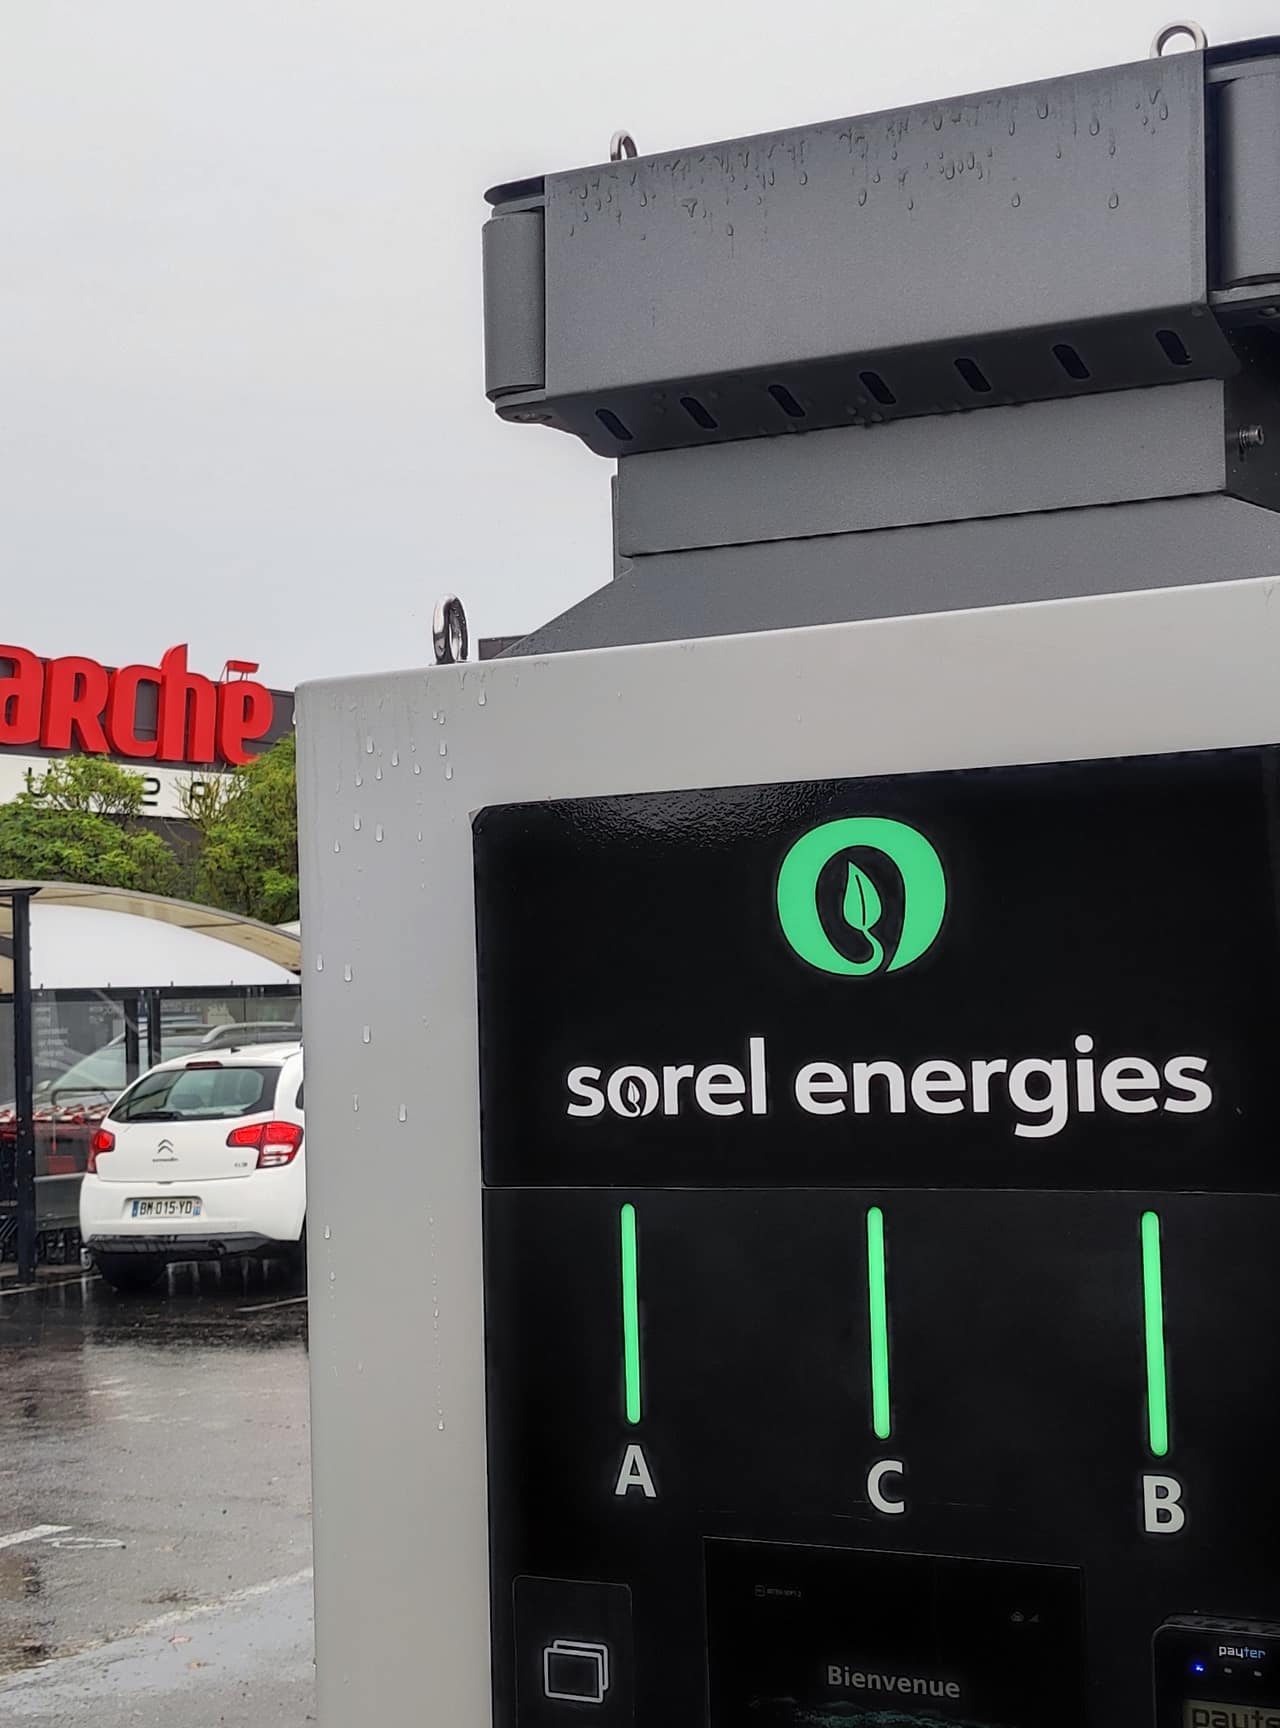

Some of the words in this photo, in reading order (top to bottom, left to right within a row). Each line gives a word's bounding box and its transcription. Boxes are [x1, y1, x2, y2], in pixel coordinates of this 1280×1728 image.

[566, 1036, 768, 1119] sorel
[795, 1034, 1213, 1138] energies
[615, 1445, 657, 1498] A
[867, 1460, 905, 1514] C
[1142, 1475, 1185, 1533] B
[1219, 1646, 1266, 1659] payter
[827, 1665, 961, 1698] Bienvenue
